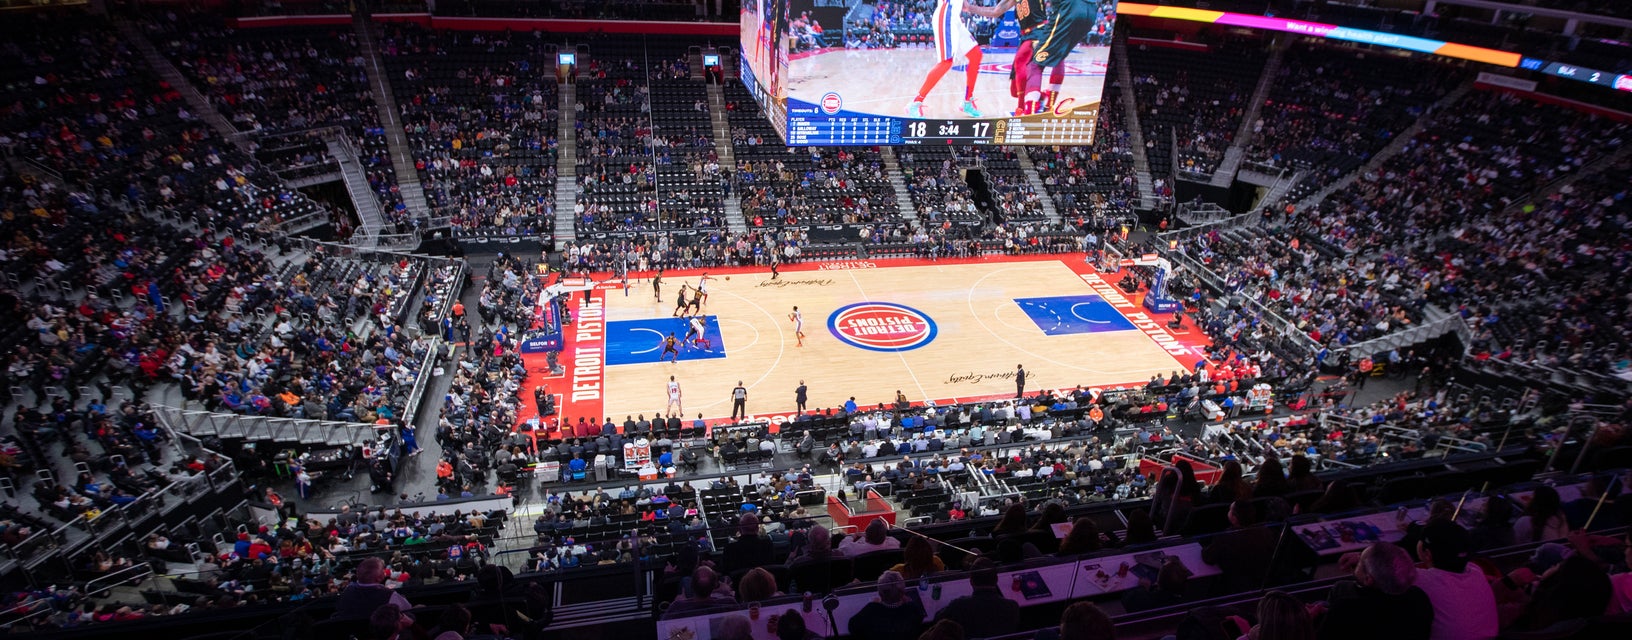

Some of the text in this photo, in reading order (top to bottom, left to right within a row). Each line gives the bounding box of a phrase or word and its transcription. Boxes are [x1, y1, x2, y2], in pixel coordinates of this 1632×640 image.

[1286, 21, 1307, 31] Want
[1589, 72, 1601, 82] 2
[908, 122, 926, 137] 18
[938, 125, 959, 136] 3:44
[972, 122, 990, 137] 17
[994, 119, 1005, 144] CLE
[1080, 272, 1192, 355] DETROIT PISTONS
[847, 315, 913, 327] PISTONS
[853, 324, 917, 336] DETROIT
[572, 297, 602, 403] DETROIT PISTONS
